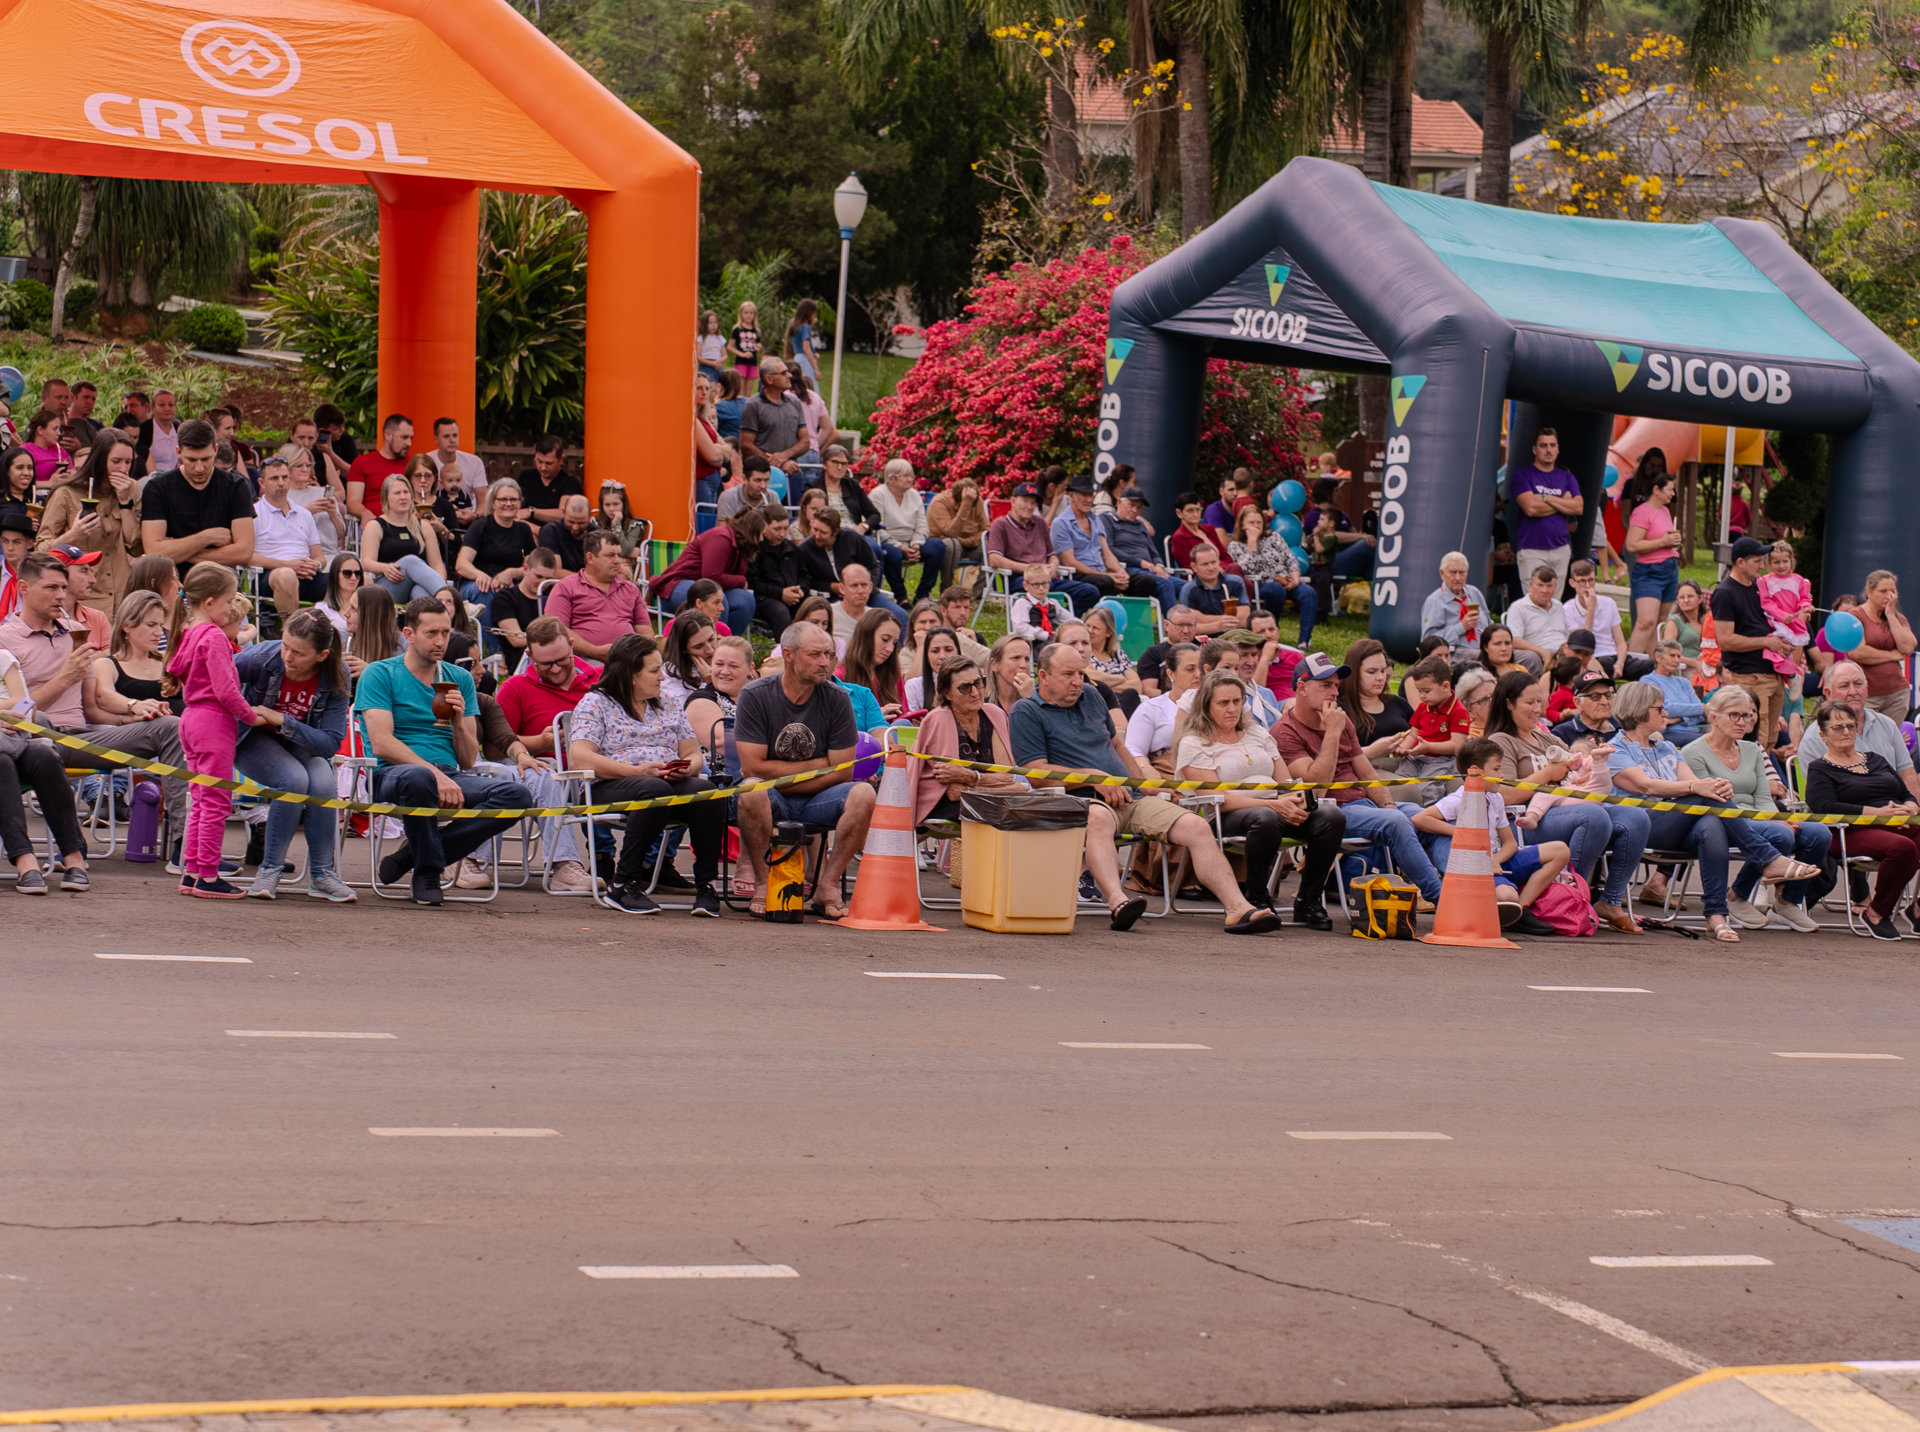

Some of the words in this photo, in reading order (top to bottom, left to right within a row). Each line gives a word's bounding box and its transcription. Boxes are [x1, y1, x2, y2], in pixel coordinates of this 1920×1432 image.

[84, 92, 428, 164] CRESOL
[1230, 307, 1308, 343] SICOOB
[1647, 353, 1792, 404] SICOOB
[1094, 392, 1121, 485] OOB
[1374, 434, 1411, 607] SICOOB
